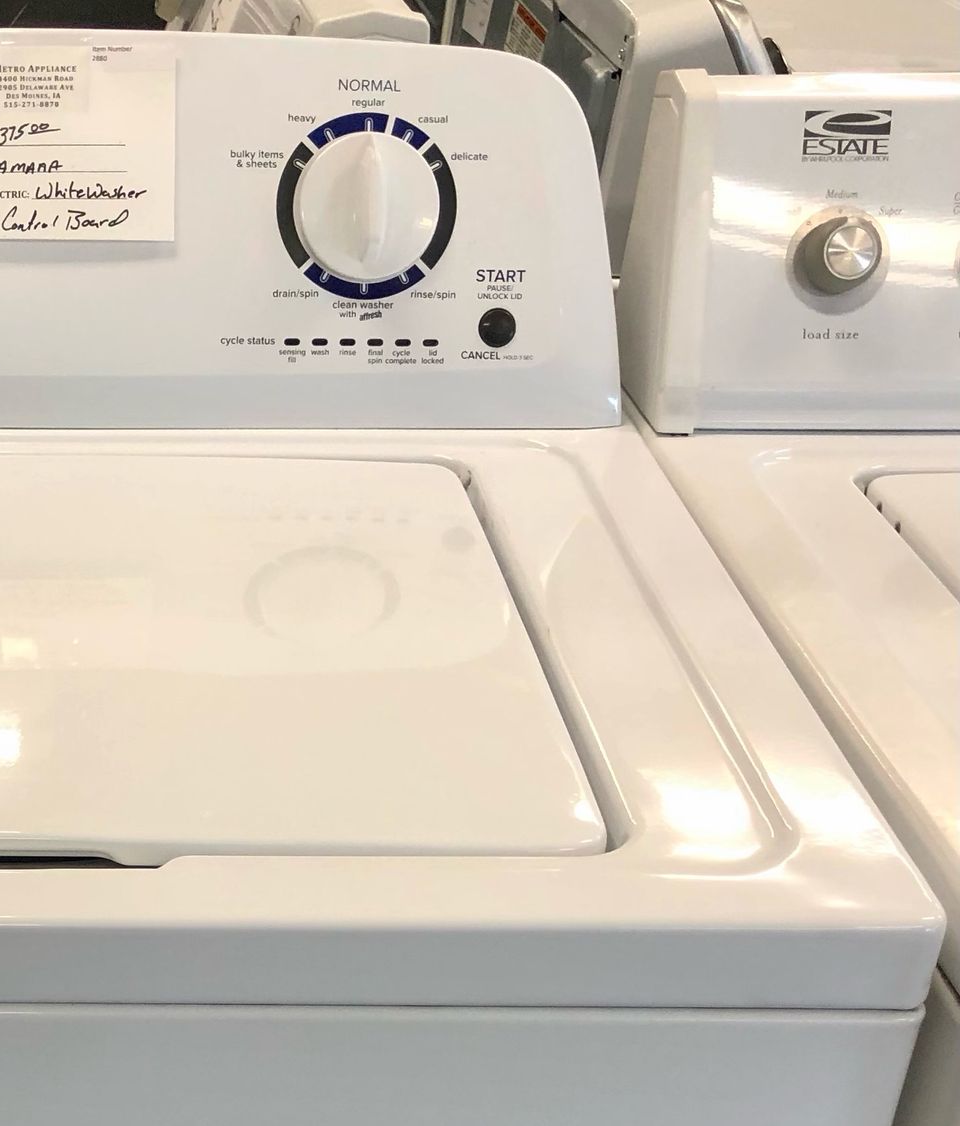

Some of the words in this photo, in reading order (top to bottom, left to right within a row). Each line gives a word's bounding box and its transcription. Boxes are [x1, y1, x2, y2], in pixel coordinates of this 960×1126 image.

[338, 79, 401, 92] NORMAL
[351, 97, 385, 108] regular
[288, 114, 316, 124] heavy
[418, 114, 448, 123] casual
[803, 138, 890, 155] ESTATE
[230, 150, 255, 160] bulky
[259, 150, 284, 159] items
[451, 152, 488, 161] delicate
[237, 160, 243, 168] &
[246, 160, 277, 168] sheets
[826, 189, 858, 199] Medium
[2, 206, 59, 232] Control
[66, 208, 129, 231] Board
[476, 270, 526, 282] START
[273, 289, 319, 300] drain/spin
[411, 290, 456, 301] rinse/spin
[332, 300, 357, 309] clean
[360, 301, 393, 309] washer
[803, 329, 830, 340] load
[835, 329, 859, 340] size
[220, 336, 245, 346] cycle
[247, 336, 276, 346] status
[278, 350, 306, 358] sensing
[392, 350, 410, 358] cycle
[461, 351, 500, 360] CANCEL
[385, 358, 417, 366] complete
[421, 357, 444, 365] locked
